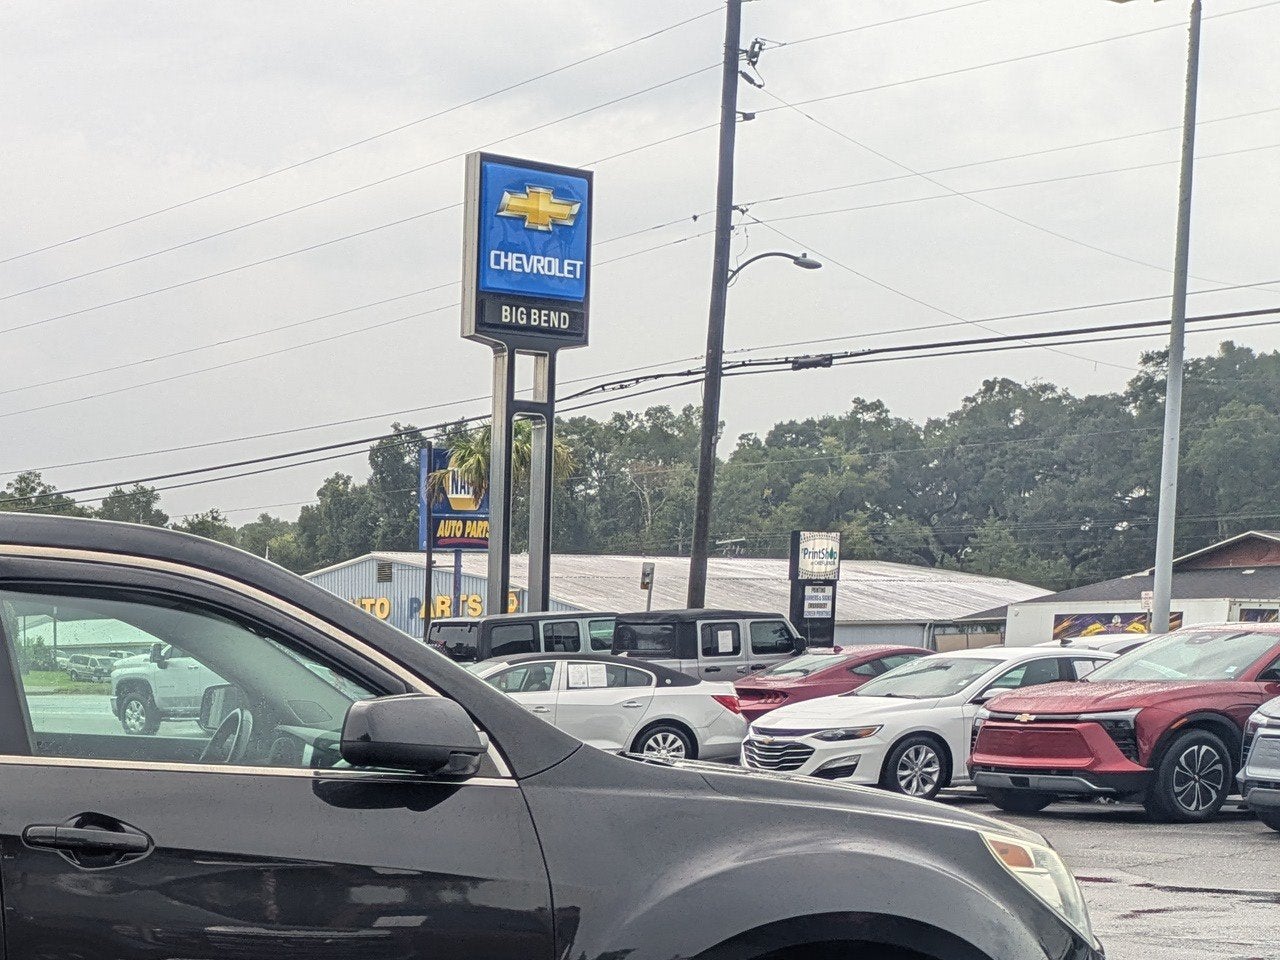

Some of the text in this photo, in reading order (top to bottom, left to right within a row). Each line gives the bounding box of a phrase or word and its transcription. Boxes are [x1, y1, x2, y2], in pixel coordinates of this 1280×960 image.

[489, 250, 583, 279] CHEVROLET
[501, 305, 570, 329] BIG BEND
[437, 519, 463, 538] AUTO
